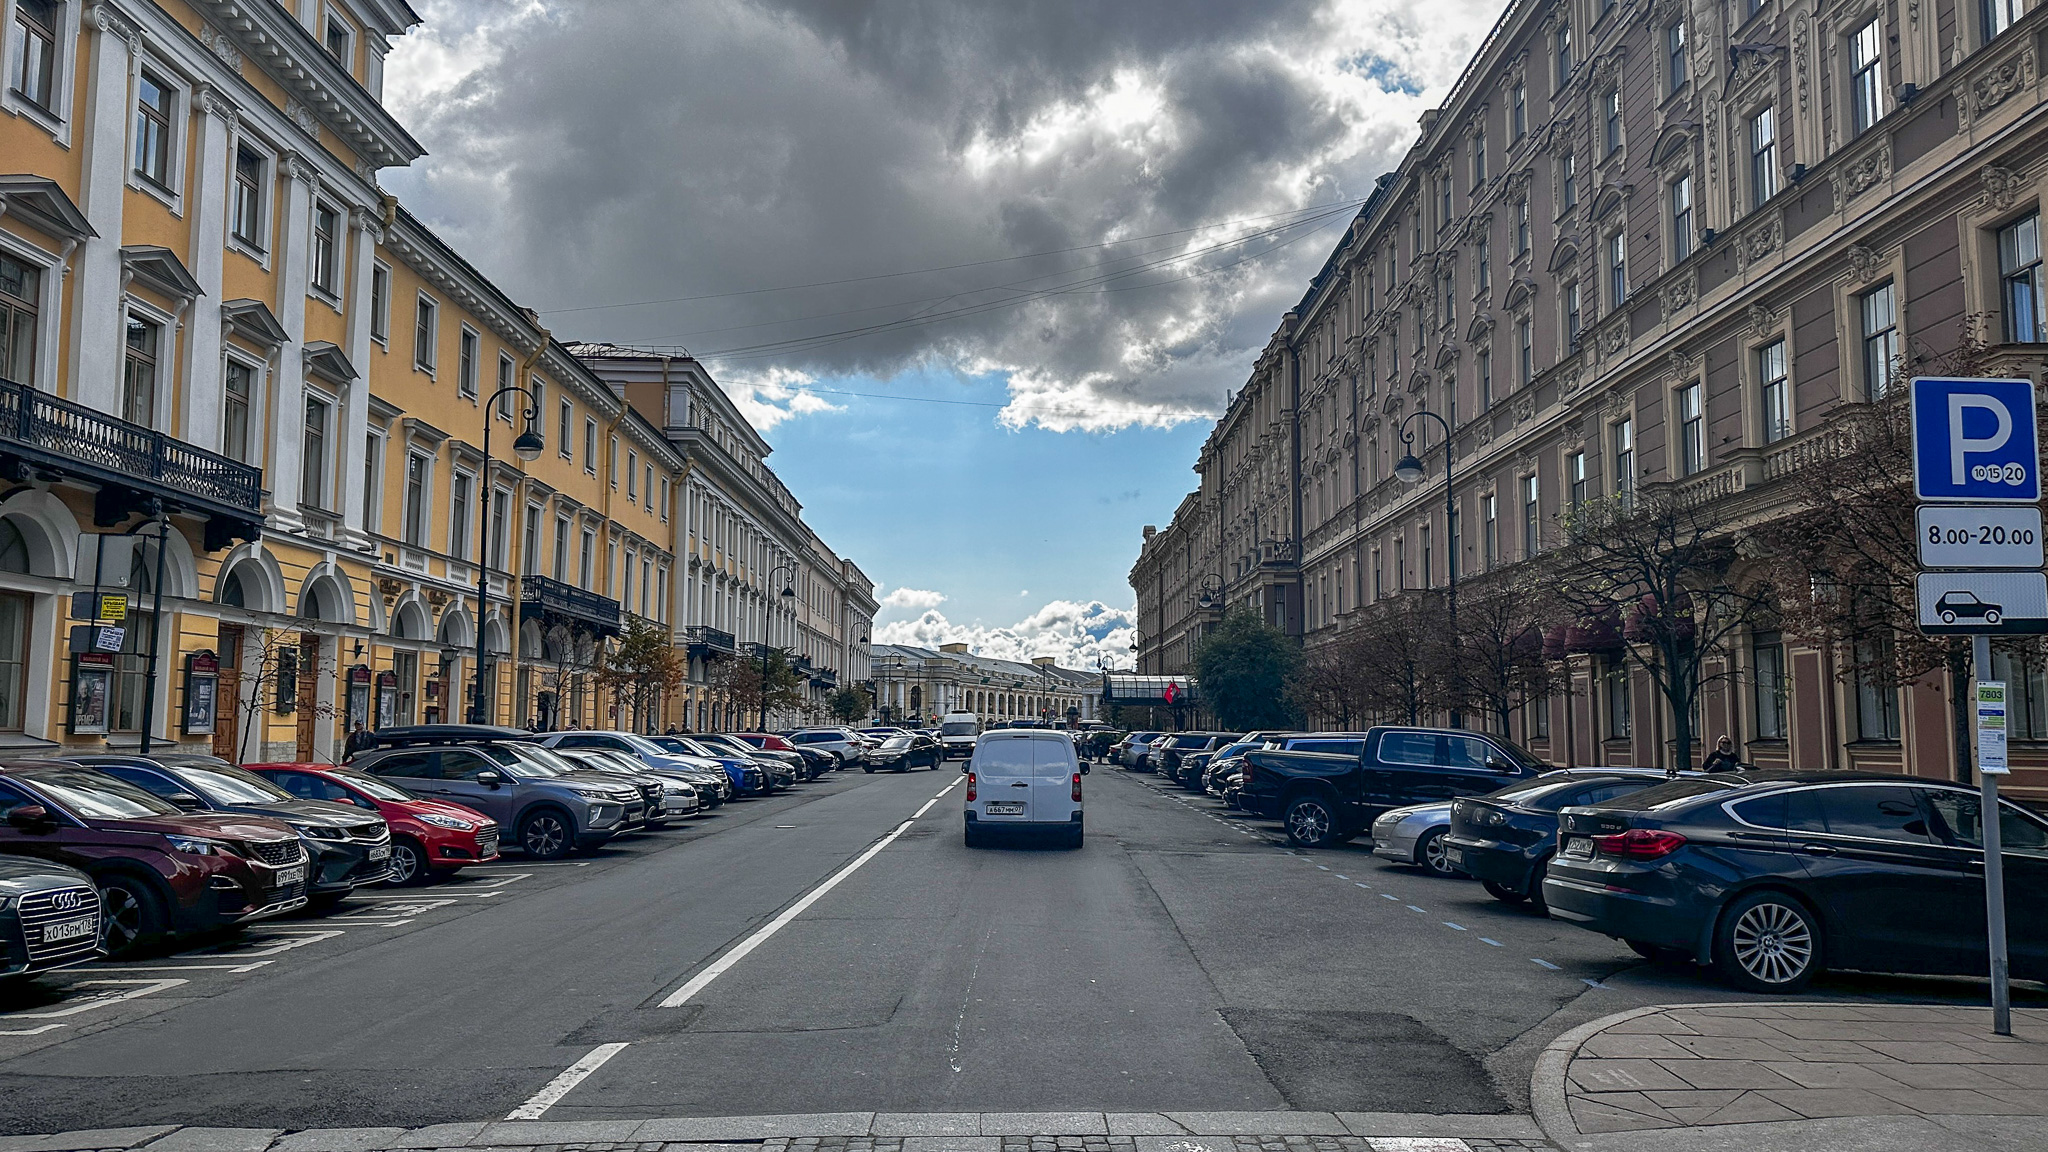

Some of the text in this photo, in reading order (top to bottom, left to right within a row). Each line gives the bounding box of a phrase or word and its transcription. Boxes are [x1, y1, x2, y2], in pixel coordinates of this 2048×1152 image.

[1948, 393, 2012, 485] P
[1974, 466, 2025, 481] 10 15 20
[1928, 525, 2034, 545] 8.00-20.00
[1980, 690, 2003, 699] 7803
